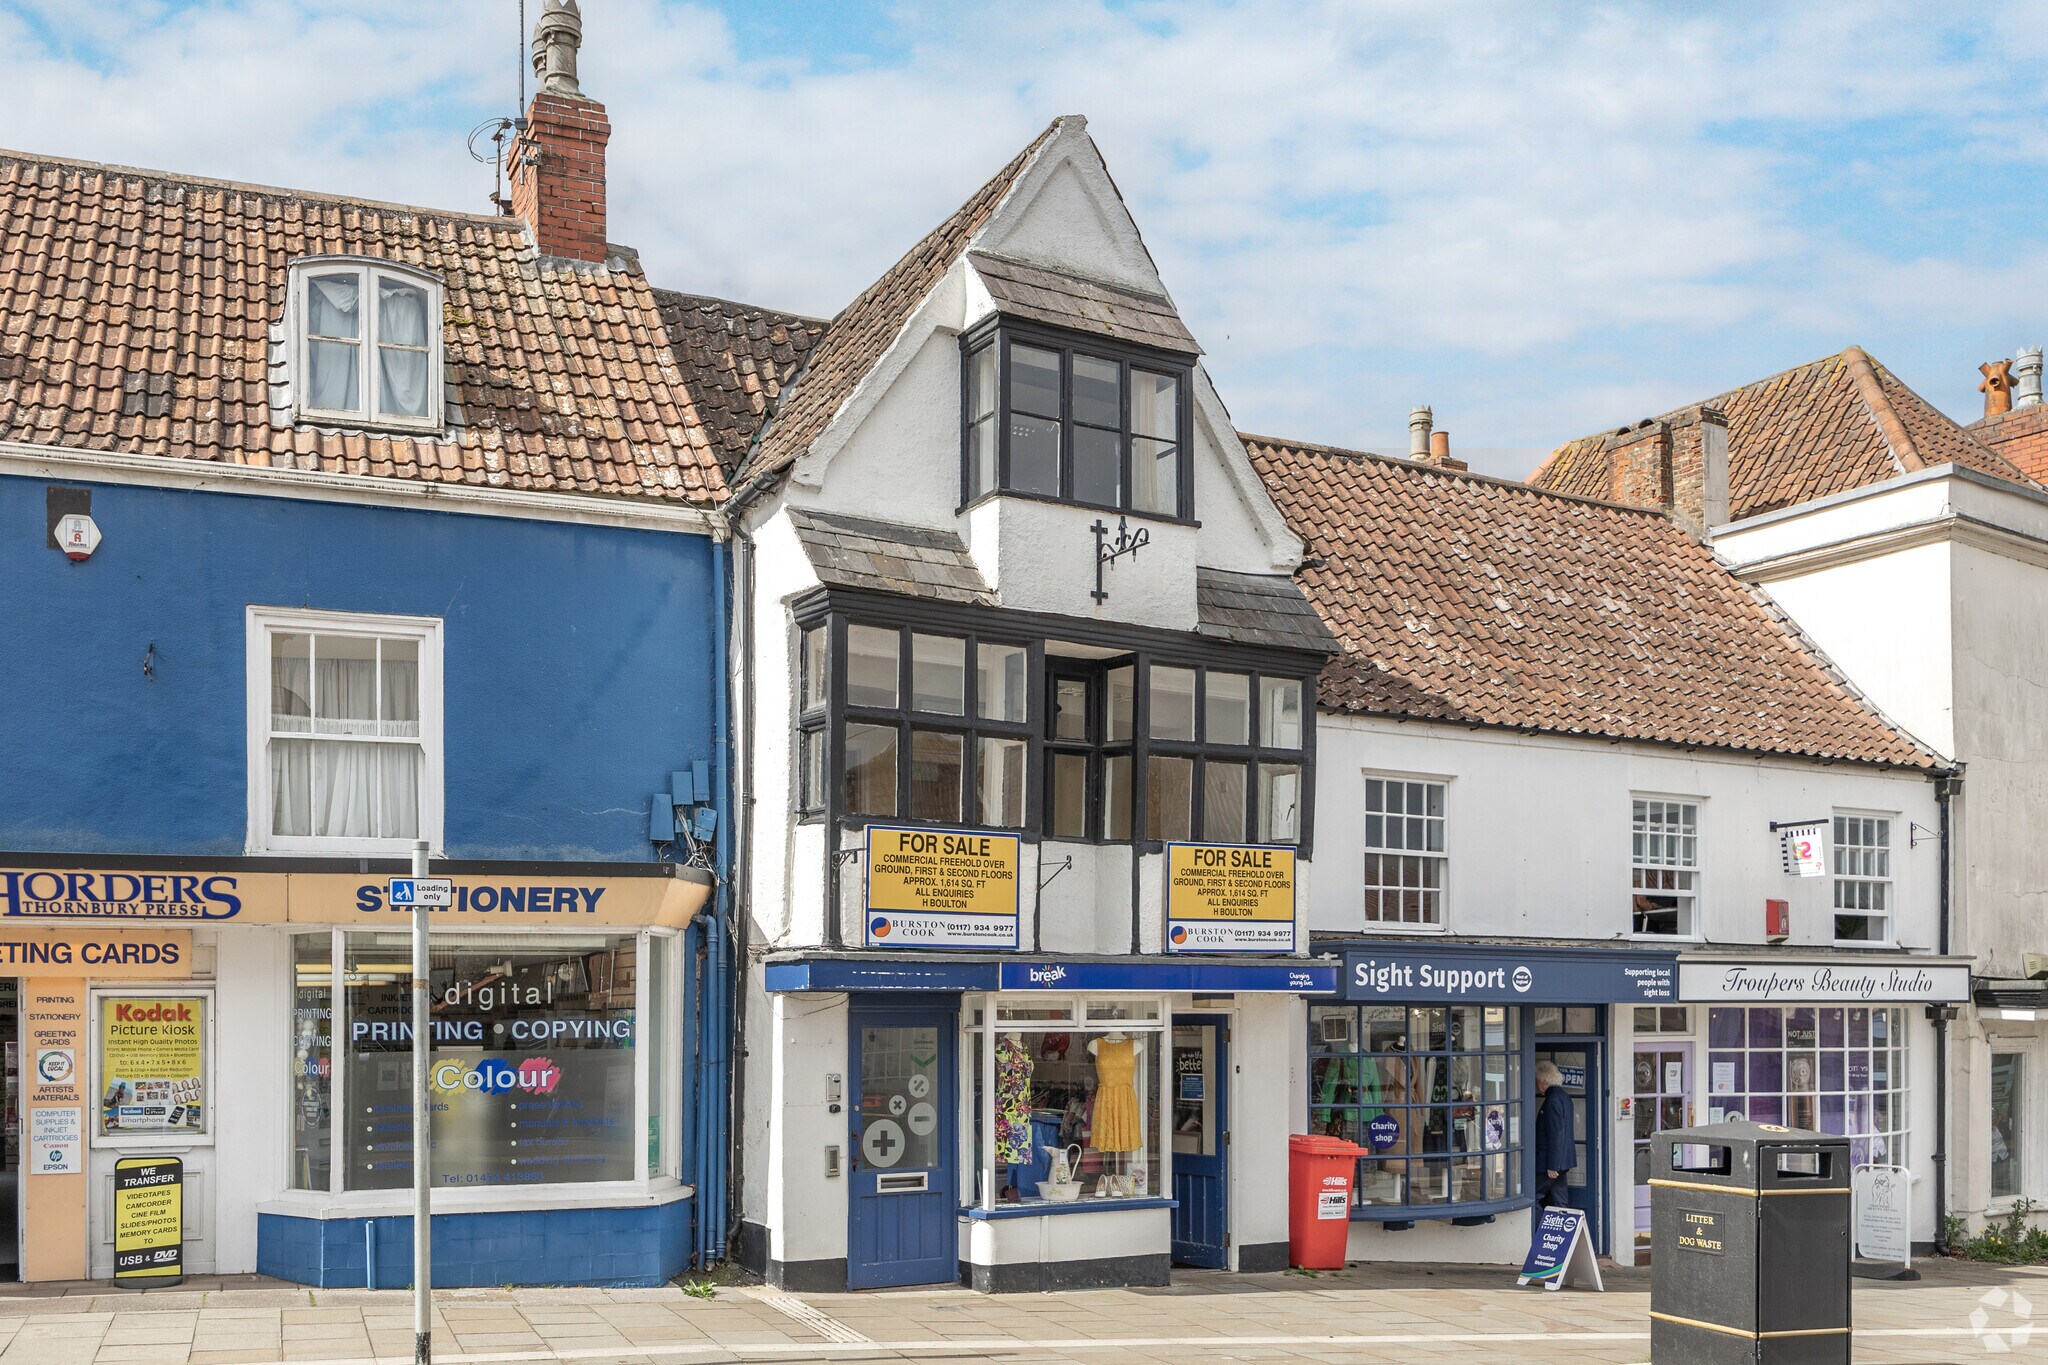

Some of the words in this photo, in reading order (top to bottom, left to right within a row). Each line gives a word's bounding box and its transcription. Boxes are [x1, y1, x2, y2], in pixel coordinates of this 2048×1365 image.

[900, 834, 938, 853] FOR
[944, 836, 990, 856] SALE
[884, 854, 937, 865] COMMERCIAL
[940, 857, 981, 866] FREEHOLD
[984, 860, 1004, 868] OVER
[1194, 849, 1226, 866] FOR
[1231, 850, 1272, 868] SALE
[875, 865, 912, 875] GROUND,
[915, 867, 937, 876] FIRST
[940, 868, 944, 876] &
[947, 869, 978, 878] SECOND
[981, 870, 1012, 879] FLOORS
[1181, 869, 1226, 877] COMMERCIAL
[1228, 870, 1264, 878] FREEHOLD
[1266, 871, 1284, 879] OVER
[903, 877, 938, 886] APPROX.
[941, 879, 959, 888] 1,614
[962, 880, 974, 888] SQ.
[1174, 878, 1205, 887] GROUND,
[1207, 879, 1226, 887] FIRST
[1235, 880, 1262, 888] SECOND
[1264, 881, 1290, 889] FLOORS
[417, 885, 448, 893] Loading
[916, 888, 930, 896] ALL
[933, 889, 974, 898] ENQUIRIES
[356, 886, 606, 912] SIONERY
[424, 893, 441, 901] only
[930, 899, 967, 908] BOULTON
[1222, 899, 1258, 907] ENQUIRIES
[22, 901, 139, 915] THORNBURY
[146, 903, 199, 916] PRESS
[892, 920, 945, 928] BURSTON
[947, 923, 970, 931] (0117)
[0, 943, 72, 964] TING
[81, 943, 179, 964] CARDS
[1030, 966, 1066, 981] break
[1290, 972, 1310, 980] Changing
[1355, 960, 1413, 993] Sight
[1420, 964, 1505, 993] Support
[1624, 968, 1656, 977] Supporting
[1657, 968, 1670, 976] local
[1637, 979, 1656, 987] people
[1722, 968, 1805, 998] Troupers
[1812, 968, 1876, 998] Beauty
[1880, 969, 1933, 992] Studio
[299, 988, 326, 1002] digital
[445, 982, 552, 1011] digital
[1644, 989, 1658, 997] sight
[116, 1003, 191, 1022] Kodak
[292, 1009, 332, 1019] PRINTING
[111, 1025, 158, 1035] Picture
[162, 1025, 194, 1035] Kiosk
[511, 1020, 631, 1040] COPYING
[1432, 1022, 1446, 1032] Sigh
[1788, 1030, 1800, 1038] NOT
[293, 1036, 332, 1046] COPYING
[295, 1061, 329, 1075] Colour
[1180, 1057, 1202, 1070] bette
[436, 1066, 554, 1090] Colour
[1371, 1122, 1397, 1131] Charity
[1375, 1134, 1393, 1142] shop
[51, 1151, 61, 1162] hp
[140, 1167, 156, 1176] WE
[124, 1174, 174, 1186] TRANSFER
[442, 1174, 462, 1183] Tel:
[1331, 1177, 1348, 1186] Hills
[127, 1190, 171, 1200] VIDEOTAPES
[1329, 1196, 1346, 1204] Hills
[126, 1199, 172, 1209] CAMCORDER
[149, 1209, 166, 1217] FILM
[120, 1217, 177, 1229] SLIDES/PHOTOS
[1544, 1214, 1564, 1226] Sight
[1686, 1214, 1714, 1225] LITTER
[120, 1229, 151, 1238] MEMORY
[153, 1226, 177, 1235] CARDS
[1696, 1227, 1702, 1236] &
[1543, 1234, 1565, 1244] Charity
[1679, 1238, 1694, 1246] DOG
[1696, 1239, 1722, 1250] WASTE
[1542, 1242, 1558, 1251] shop
[120, 1255, 143, 1266] USB
[154, 1250, 177, 1260] DVD
